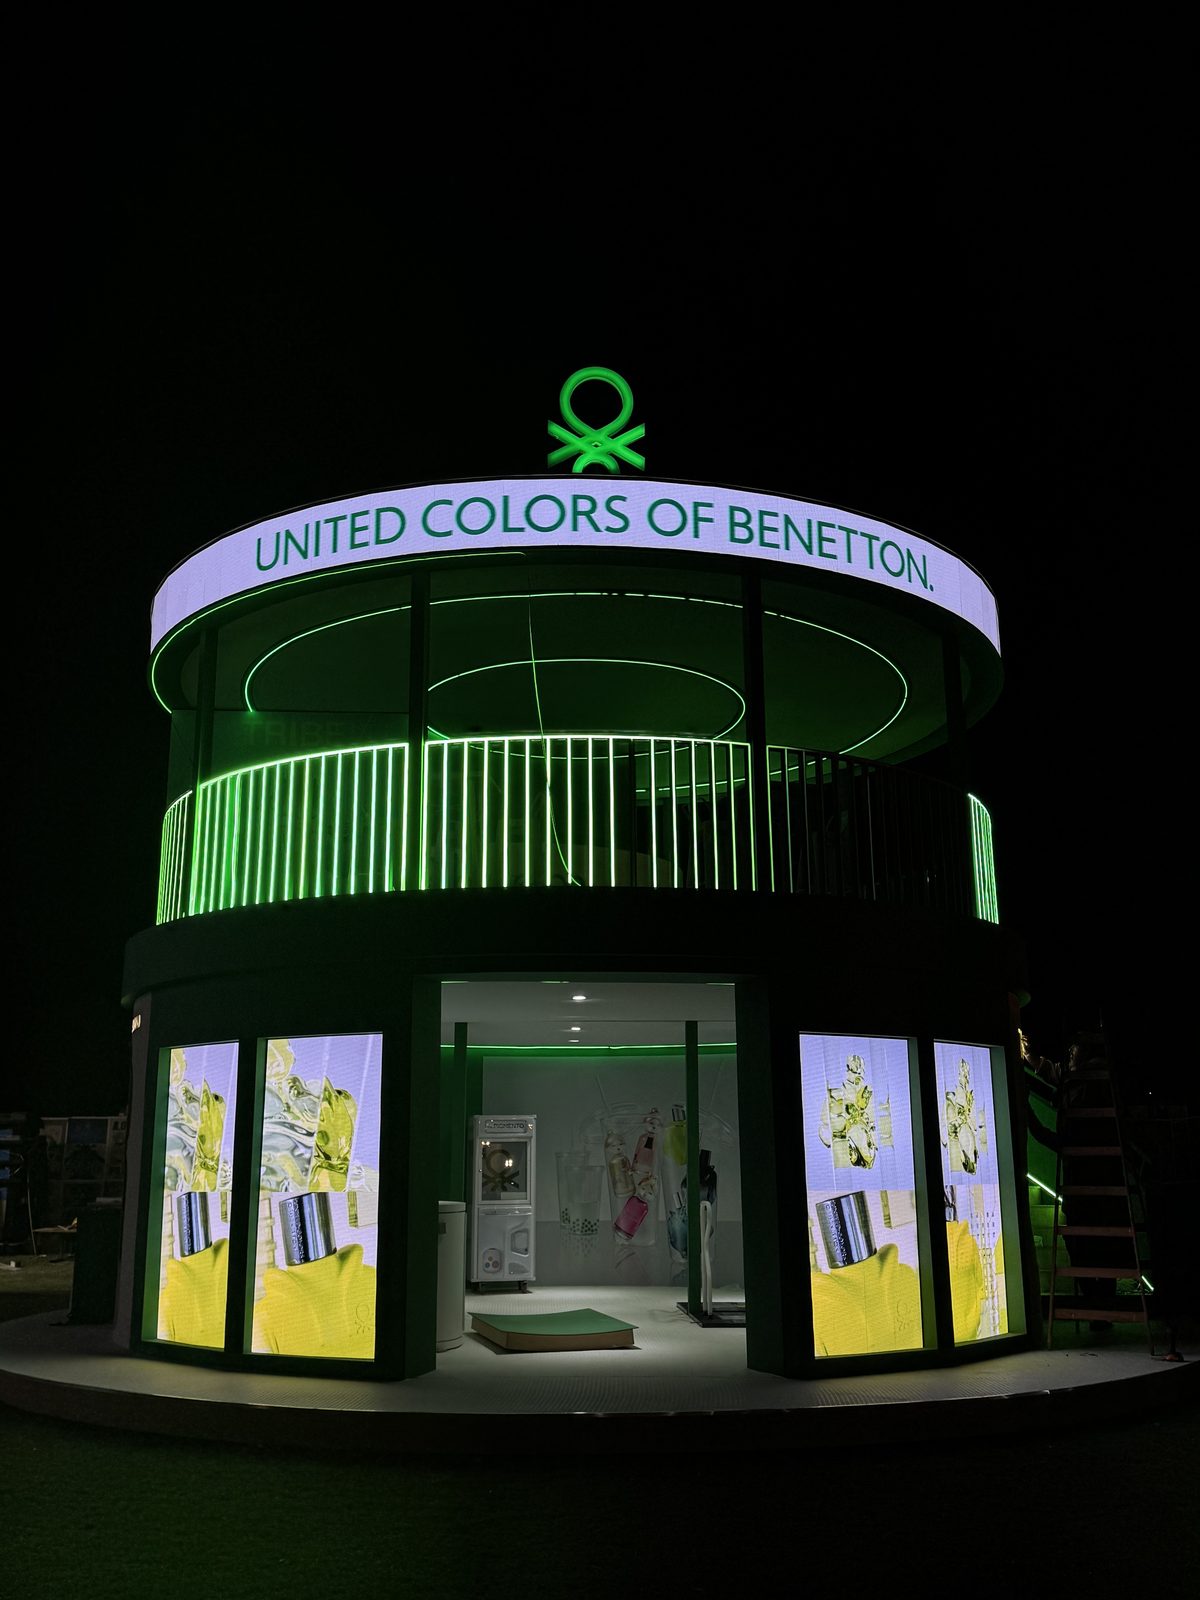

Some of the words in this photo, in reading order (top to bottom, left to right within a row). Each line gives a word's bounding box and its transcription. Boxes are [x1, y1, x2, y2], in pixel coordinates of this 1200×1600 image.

[256, 506, 406, 572] UNITED
[421, 494, 630, 538] COLORS
[647, 498, 714, 539] OF
[728, 505, 934, 592] BENETTON.
